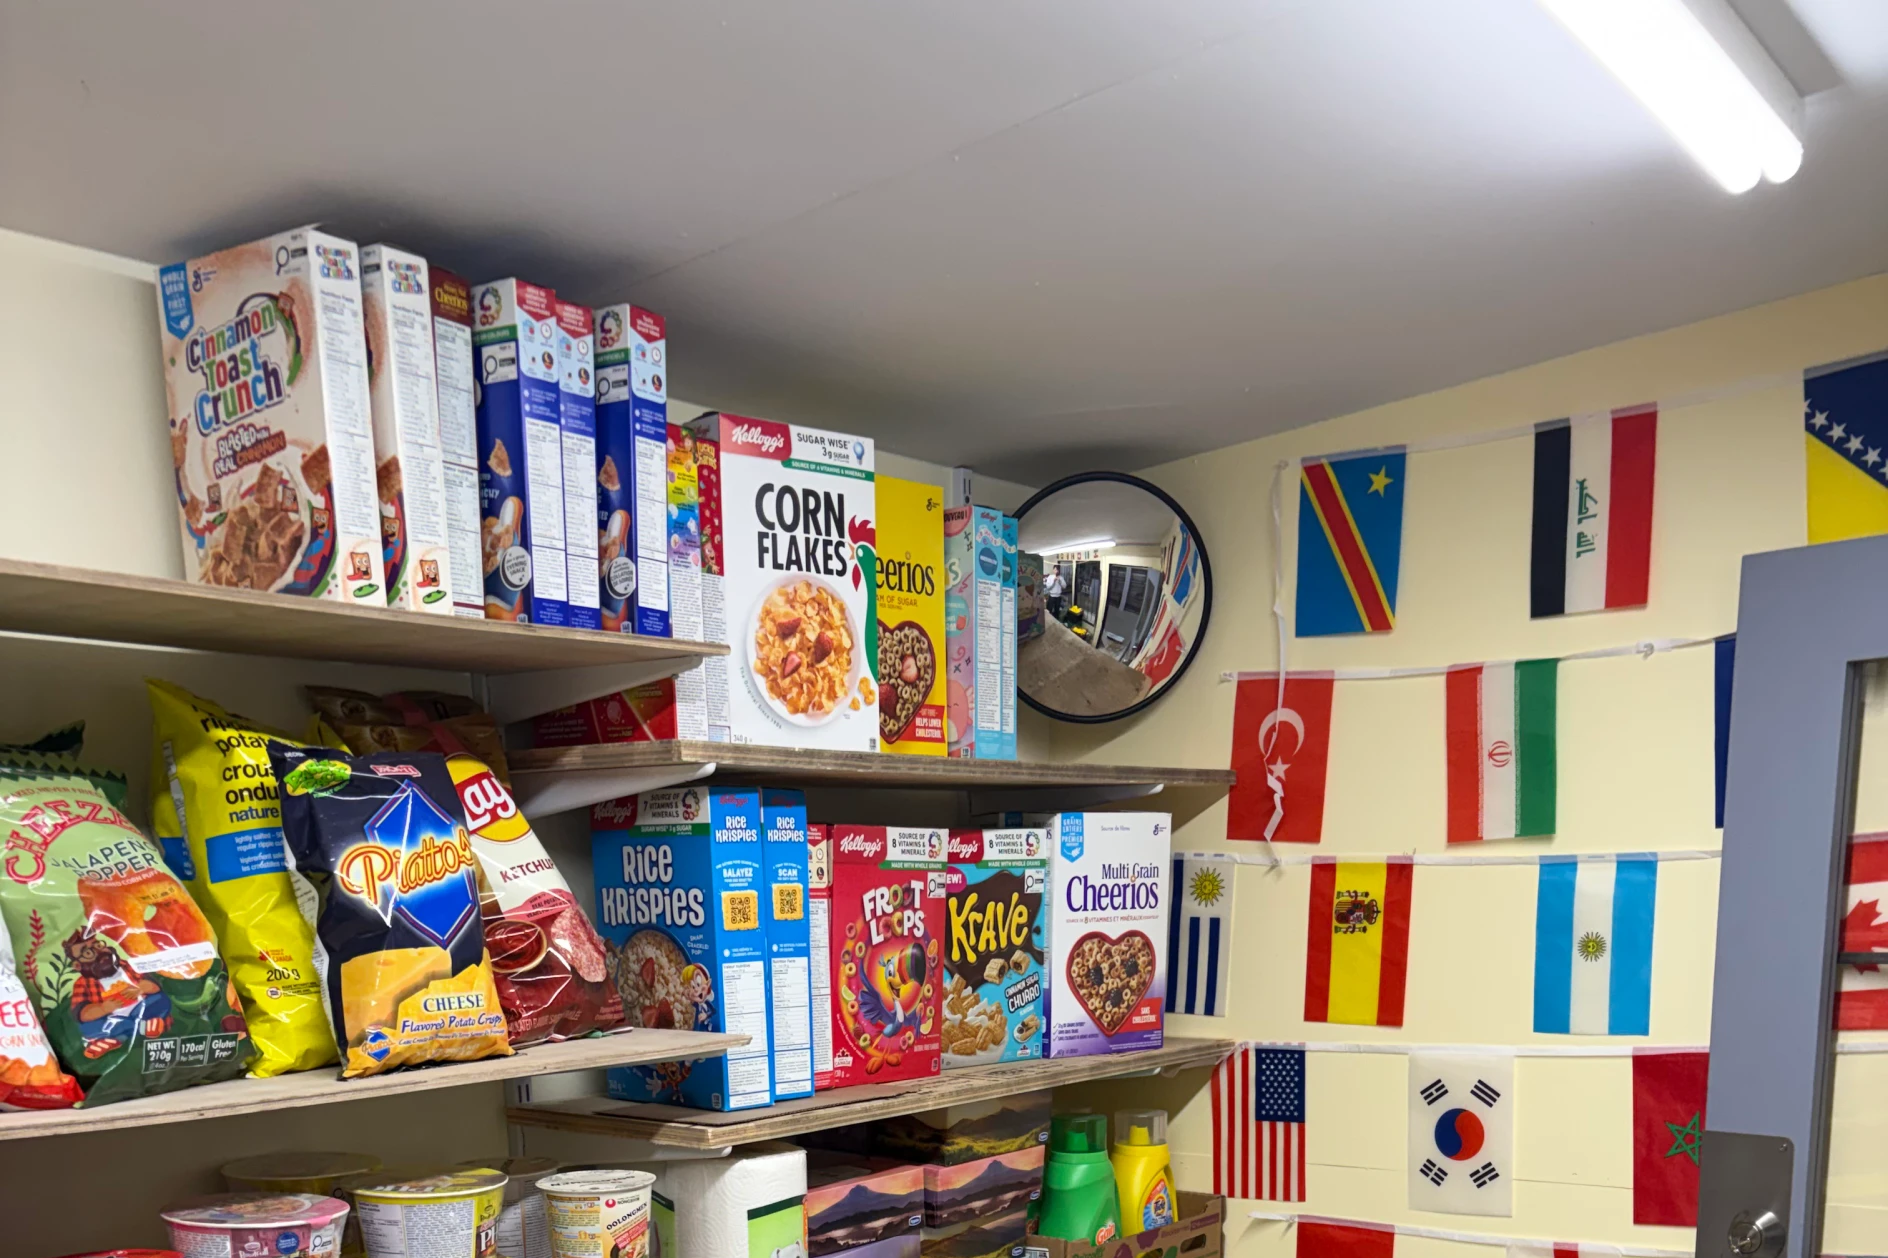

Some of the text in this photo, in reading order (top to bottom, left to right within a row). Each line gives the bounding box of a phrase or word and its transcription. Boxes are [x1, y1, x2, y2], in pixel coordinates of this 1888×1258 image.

[190, 304, 275, 367] Cinnamon
[206, 337, 262, 392] Toast
[198, 360, 283, 430] Crunch
[218, 425, 257, 459] BLASTED
[732, 424, 785, 453] Kellogg's
[797, 433, 826, 446] SUGAR
[214, 432, 286, 478] REAL CINNAMON
[791, 461, 809, 470] SOURCE
[833, 452, 850, 460] SUGAR
[755, 483, 845, 539] CORN
[757, 531, 848, 577] FLAKES
[876, 556, 935, 597] eerios
[463, 775, 518, 832] Lay
[671, 792, 680, 800] OF
[229, 806, 280, 823] nature
[594, 801, 632, 823] Kellogg's
[652, 810, 680, 819] MINERALS
[840, 833, 883, 857] Kellogg's
[892, 839, 897, 849] 8
[898, 832, 916, 840] SOURCE
[989, 839, 994, 849] 8
[73, 853, 158, 882] POPPER
[340, 830, 474, 907] Piattos
[722, 867, 753, 878] BALAYEZ
[778, 868, 797, 877] SCAN
[1102, 863, 1159, 880] Multi Grain
[862, 879, 925, 922] FROOT
[1066, 874, 1159, 912] Cheerios
[869, 910, 925, 945] LOOPS
[1089, 915, 1112, 923] VITAMINES
[266, 968, 290, 982] 200
[1005, 973, 1039, 998] CINNAMON SUGAR
[423, 993, 484, 1012] CHEESE
[1008, 984, 1040, 1011] CHURRO
[401, 1017, 446, 1034] Flavored
[447, 1014, 476, 1028] Potato
[477, 1012, 503, 1026] Crisps
[147, 1042, 161, 1051] NET
[211, 1040, 236, 1050] Gluten
[149, 1051, 172, 1062] 210g
[606, 1201, 648, 1231] OOLONGMEN
